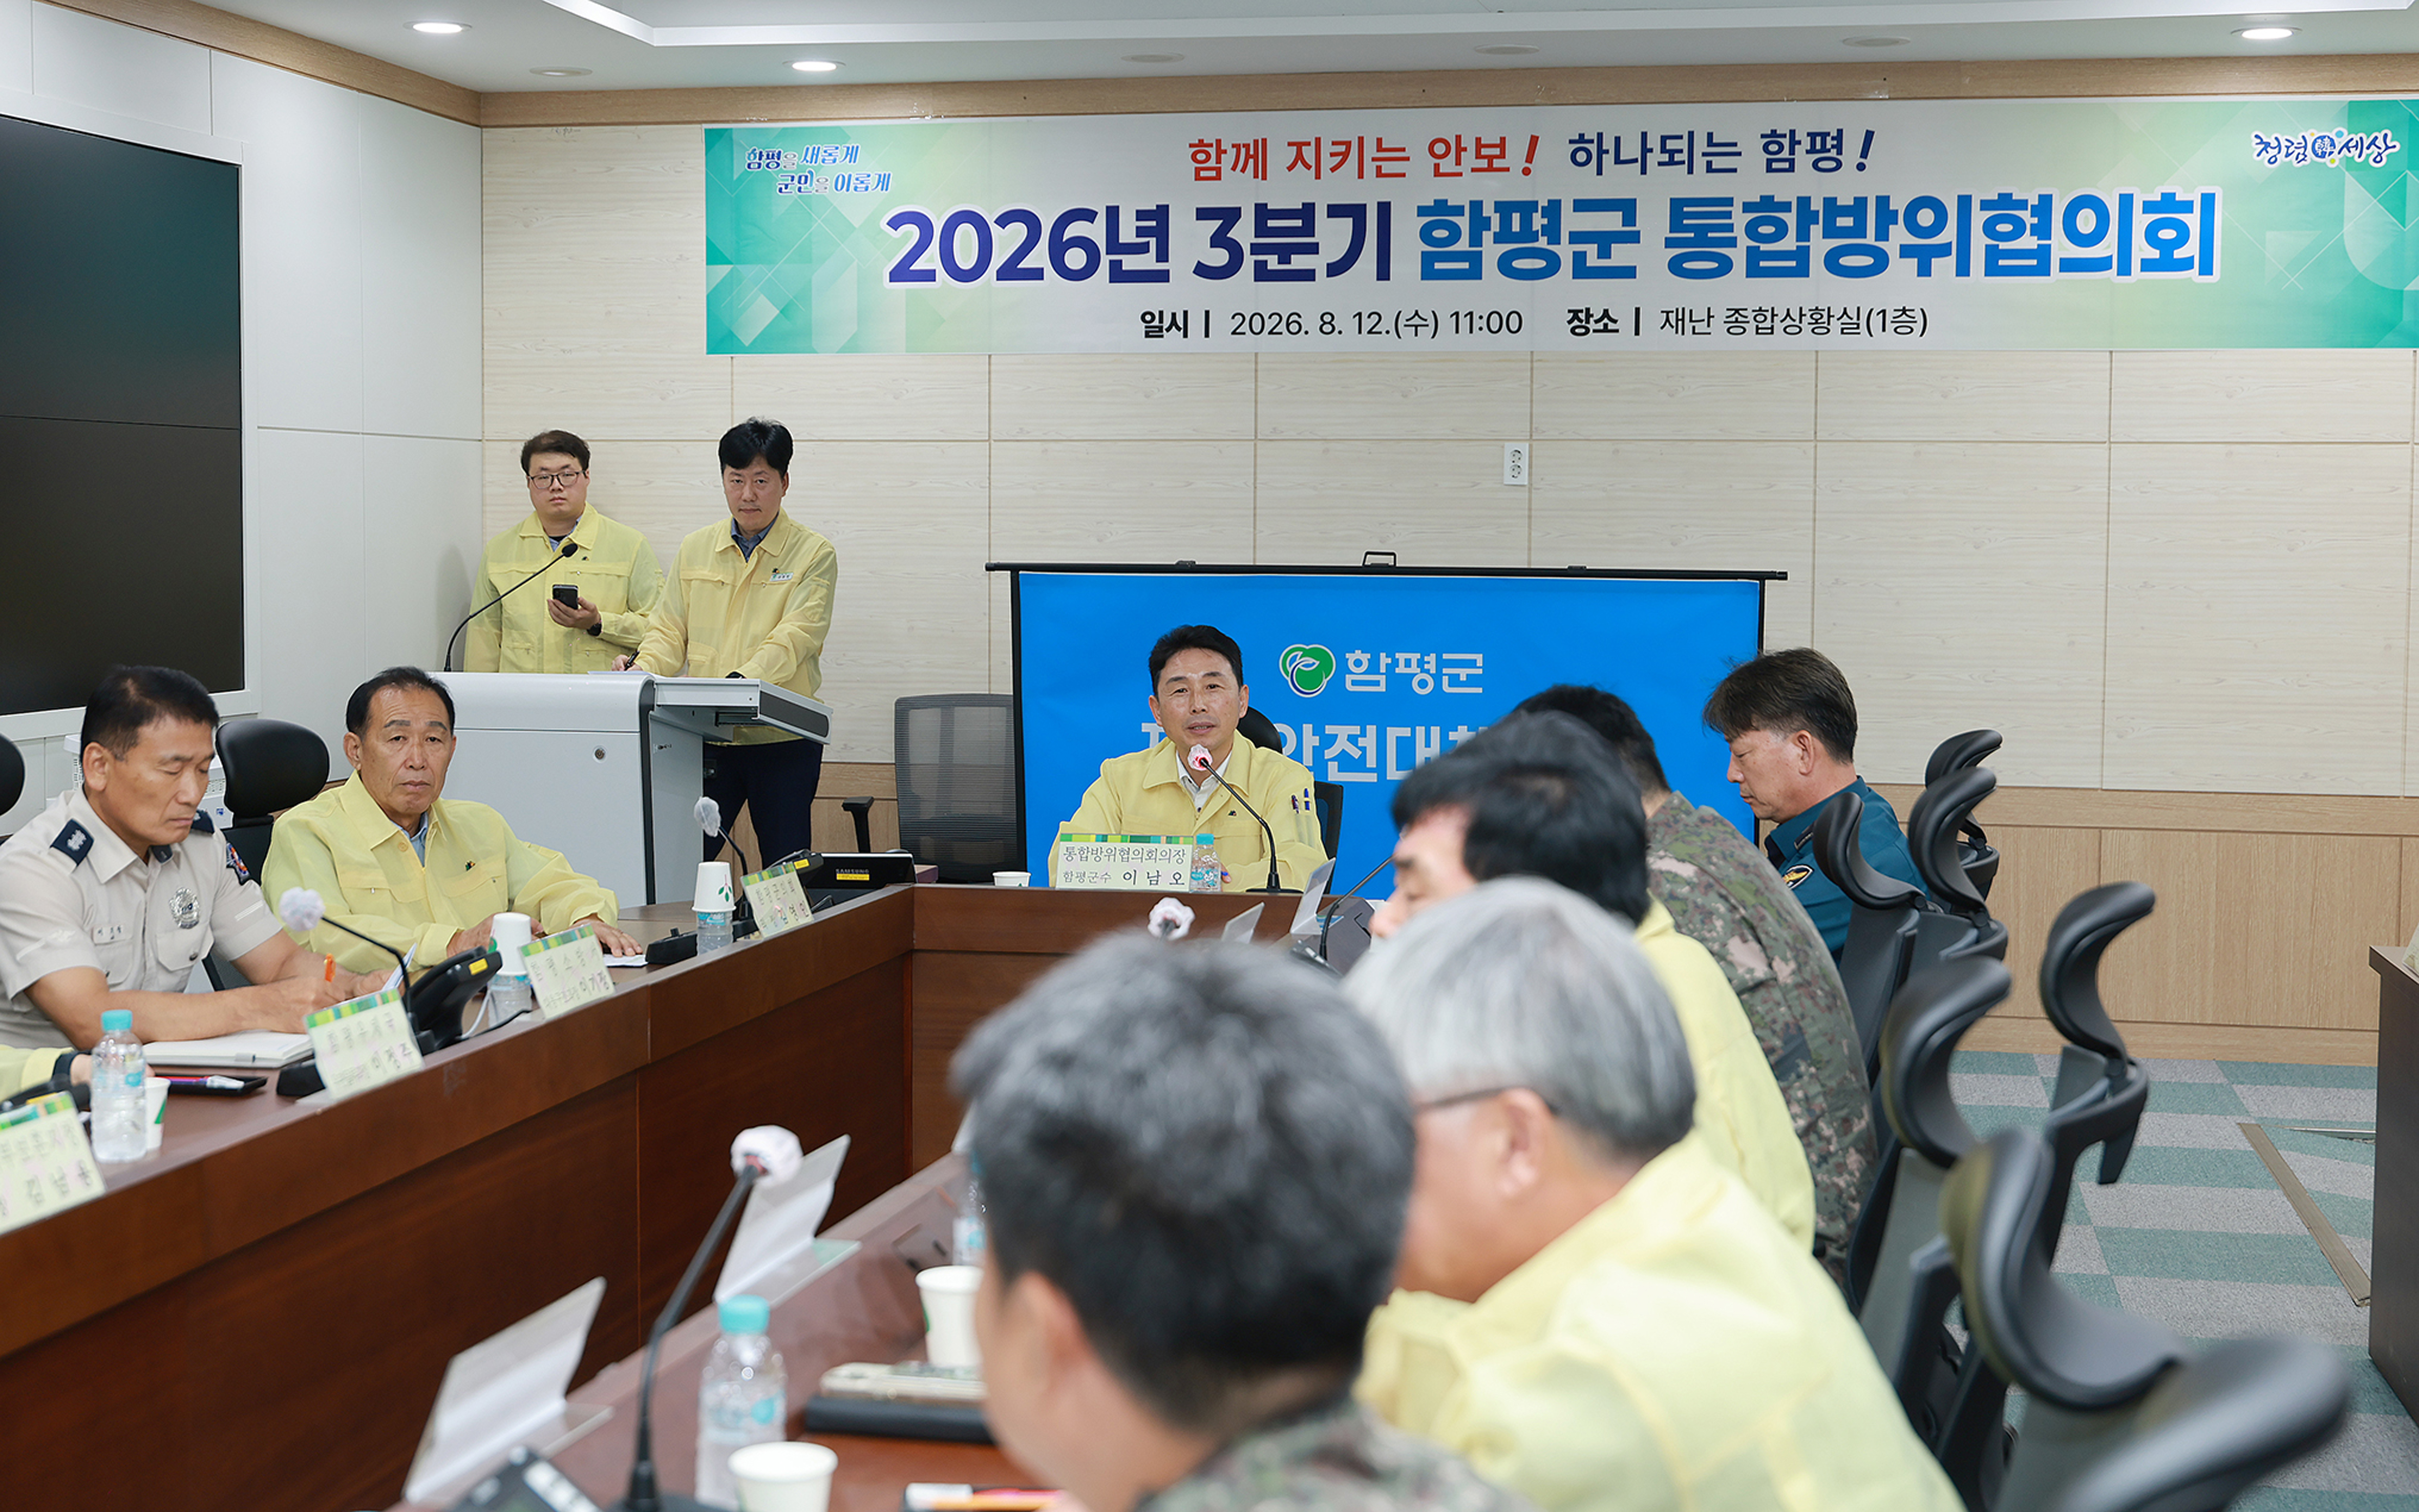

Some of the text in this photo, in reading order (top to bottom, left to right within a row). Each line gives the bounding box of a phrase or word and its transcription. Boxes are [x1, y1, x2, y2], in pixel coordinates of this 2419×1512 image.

[746, 144, 860, 169] 함평을 새롭게
[1189, 138, 1267, 181] 함께
[1286, 136, 1410, 180] 지키는
[1568, 130, 1742, 176] 하나되는
[777, 169, 892, 194] 군민을 이롭게
[885, 192, 2216, 283] 2026년 3분기 함평군 통합방위협의회
[1140, 306, 1928, 340] 일시 2026. 8. 12.(수) 11:00 장소 재난 종합상황실(1층)
[1345, 650, 1483, 695] 함평군
[1064, 846, 1186, 865] 통합방위협의회의장
[1063, 871, 1112, 884] 함평군수
